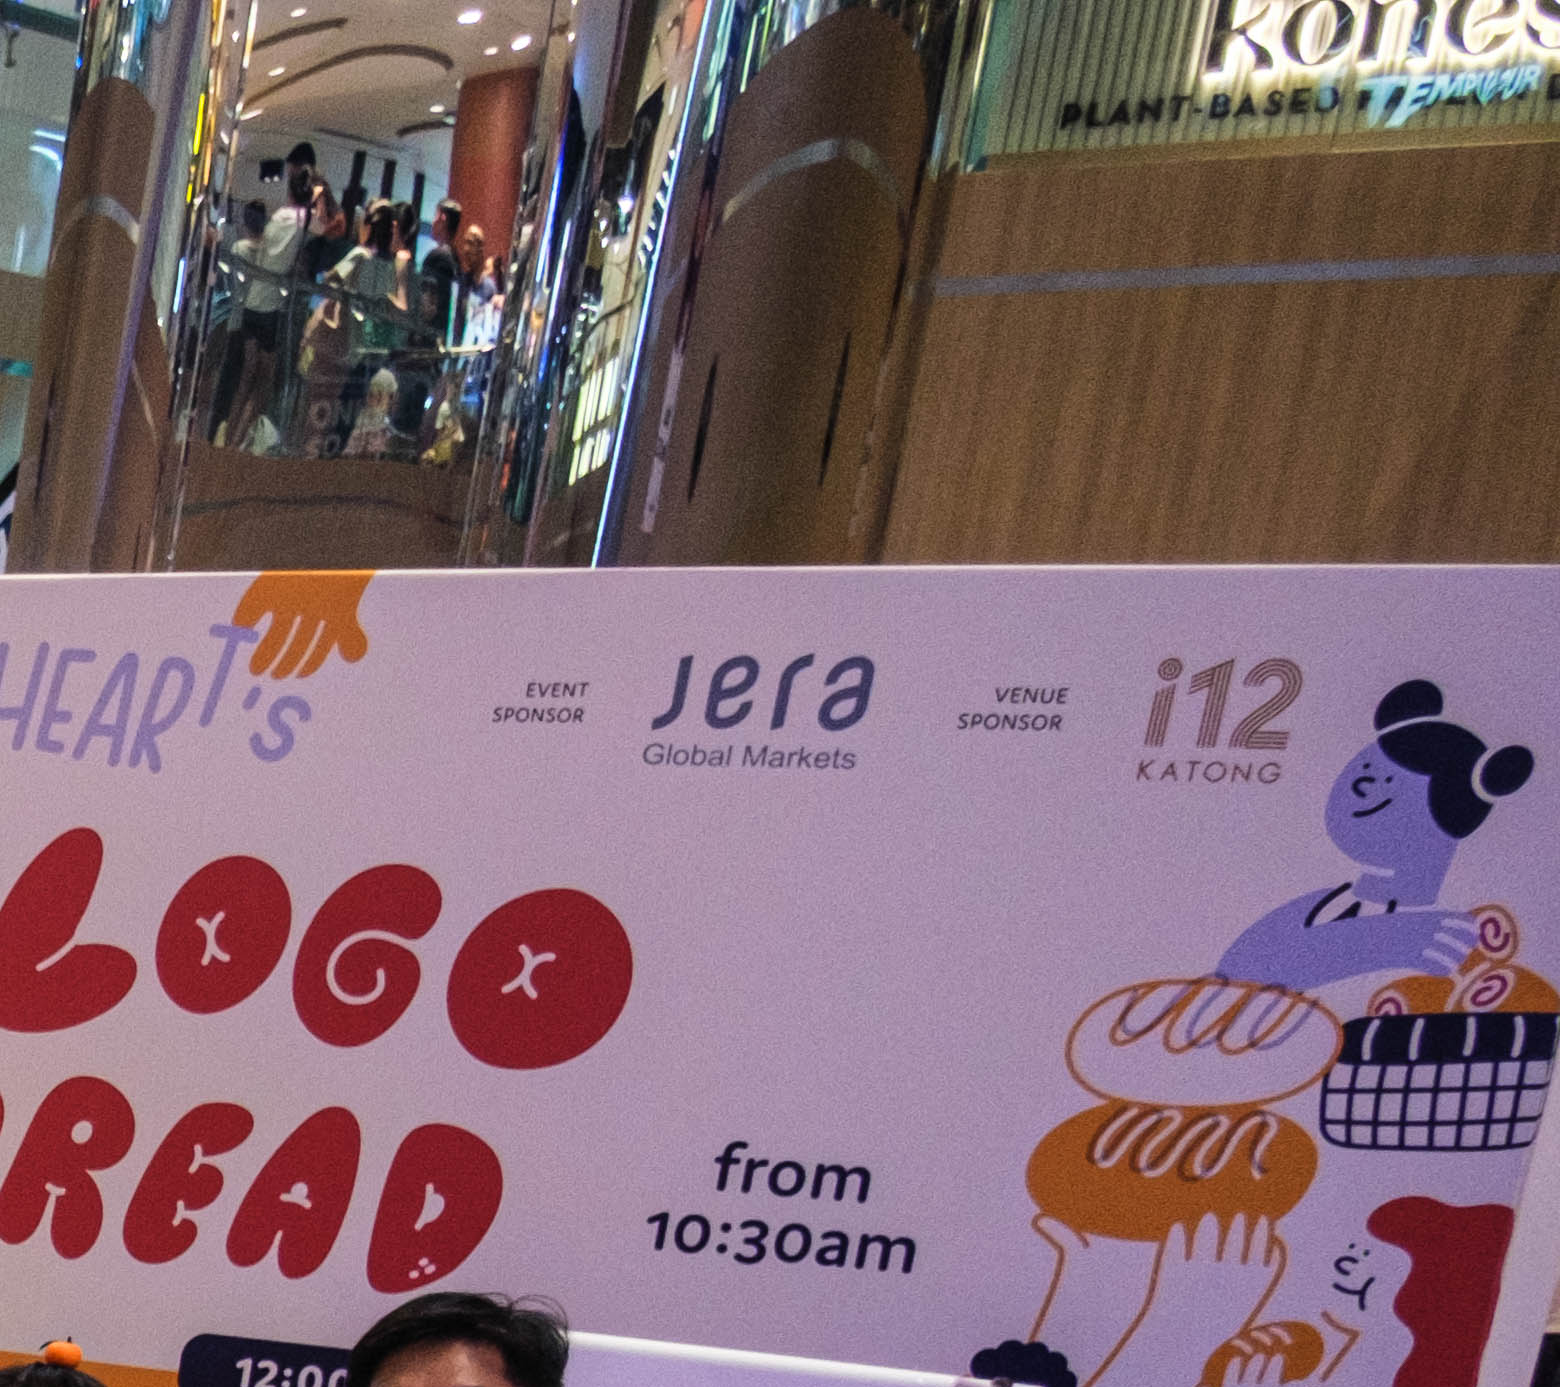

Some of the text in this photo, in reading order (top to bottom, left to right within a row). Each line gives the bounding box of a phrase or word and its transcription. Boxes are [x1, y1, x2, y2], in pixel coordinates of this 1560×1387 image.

[525, 682, 589, 699] EVENT
[994, 687, 1070, 705] VENUE
[492, 706, 586, 725] SPONSOR
[1142, 657, 1303, 751] i12
[957, 712, 1062, 732] SPONSOR
[642, 742, 857, 771] Global Markets
[1135, 760, 1283, 785] KATONG
[715, 1142, 872, 1206] from
[644, 1211, 917, 1275] 10:30am
